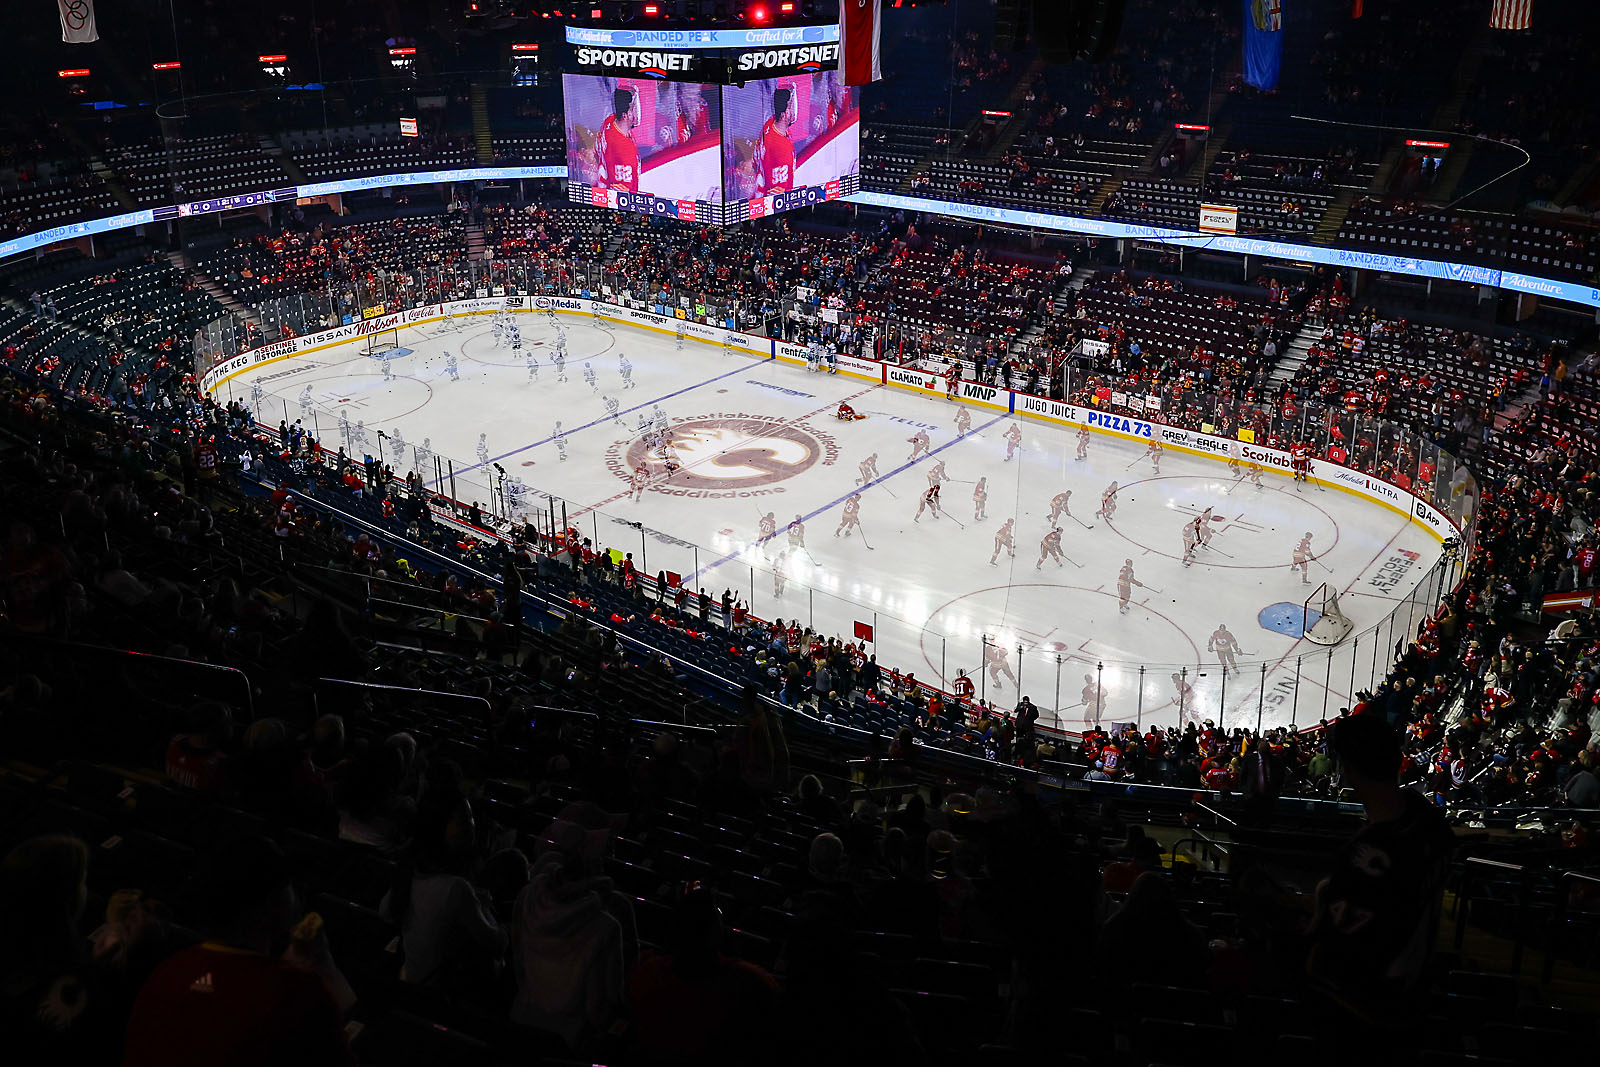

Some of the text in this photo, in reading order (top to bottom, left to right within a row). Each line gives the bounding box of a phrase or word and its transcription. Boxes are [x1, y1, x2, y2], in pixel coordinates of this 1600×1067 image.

[635, 31, 684, 42] BANDED
[745, 30, 780, 44] Crafted
[782, 29, 794, 43] for
[577, 48, 694, 71] SPORTSNET
[738, 44, 840, 71] SPORTSNET
[520, 166, 553, 175] BANDED
[360, 176, 393, 186] BANDED
[808, 191, 816, 201] 0
[864, 193, 888, 203] Crafted
[202, 203, 211, 211] 0
[246, 196, 254, 204] 0
[619, 196, 629, 207] 0
[656, 202, 666, 213] 0
[775, 198, 784, 209] 0
[949, 203, 983, 215] BANDED
[108, 217, 133, 227] Crafted
[1025, 213, 1051, 225] Crafted
[1051, 216, 1065, 226] for
[34, 227, 66, 242] BANDED
[1216, 238, 1251, 251] Crafted
[1250, 243, 1266, 253] for
[1338, 251, 1388, 265] BANDED
[506, 297, 524, 306] SN
[552, 299, 582, 309] Medals
[630, 311, 668, 324] SPORTSNET
[353, 315, 399, 336] Molson
[303, 328, 353, 347] NISSAN
[260, 340, 297, 354] SENTINEL
[1083, 341, 1108, 349] NISSAN
[261, 346, 298, 360] STORAGE
[214, 356, 248, 378] THE KEG
[891, 371, 923, 386] CLAMATO
[963, 384, 997, 401] MNP
[1024, 398, 1076, 420] JUGO JUICE
[671, 412, 786, 423] Scotiabank
[889, 416, 938, 430] TELUS
[1088, 411, 1152, 437] PIZZA 73
[1162, 430, 1229, 452] GREY EAGLE
[648, 485, 787, 500] Saddledome
[1371, 482, 1399, 501] ULTRA
[761, 522, 770, 532] 70
[1367, 556, 1396, 590] SOLAR
[1378, 559, 1414, 594] FIREFLY
[956, 684, 964, 695] 11
